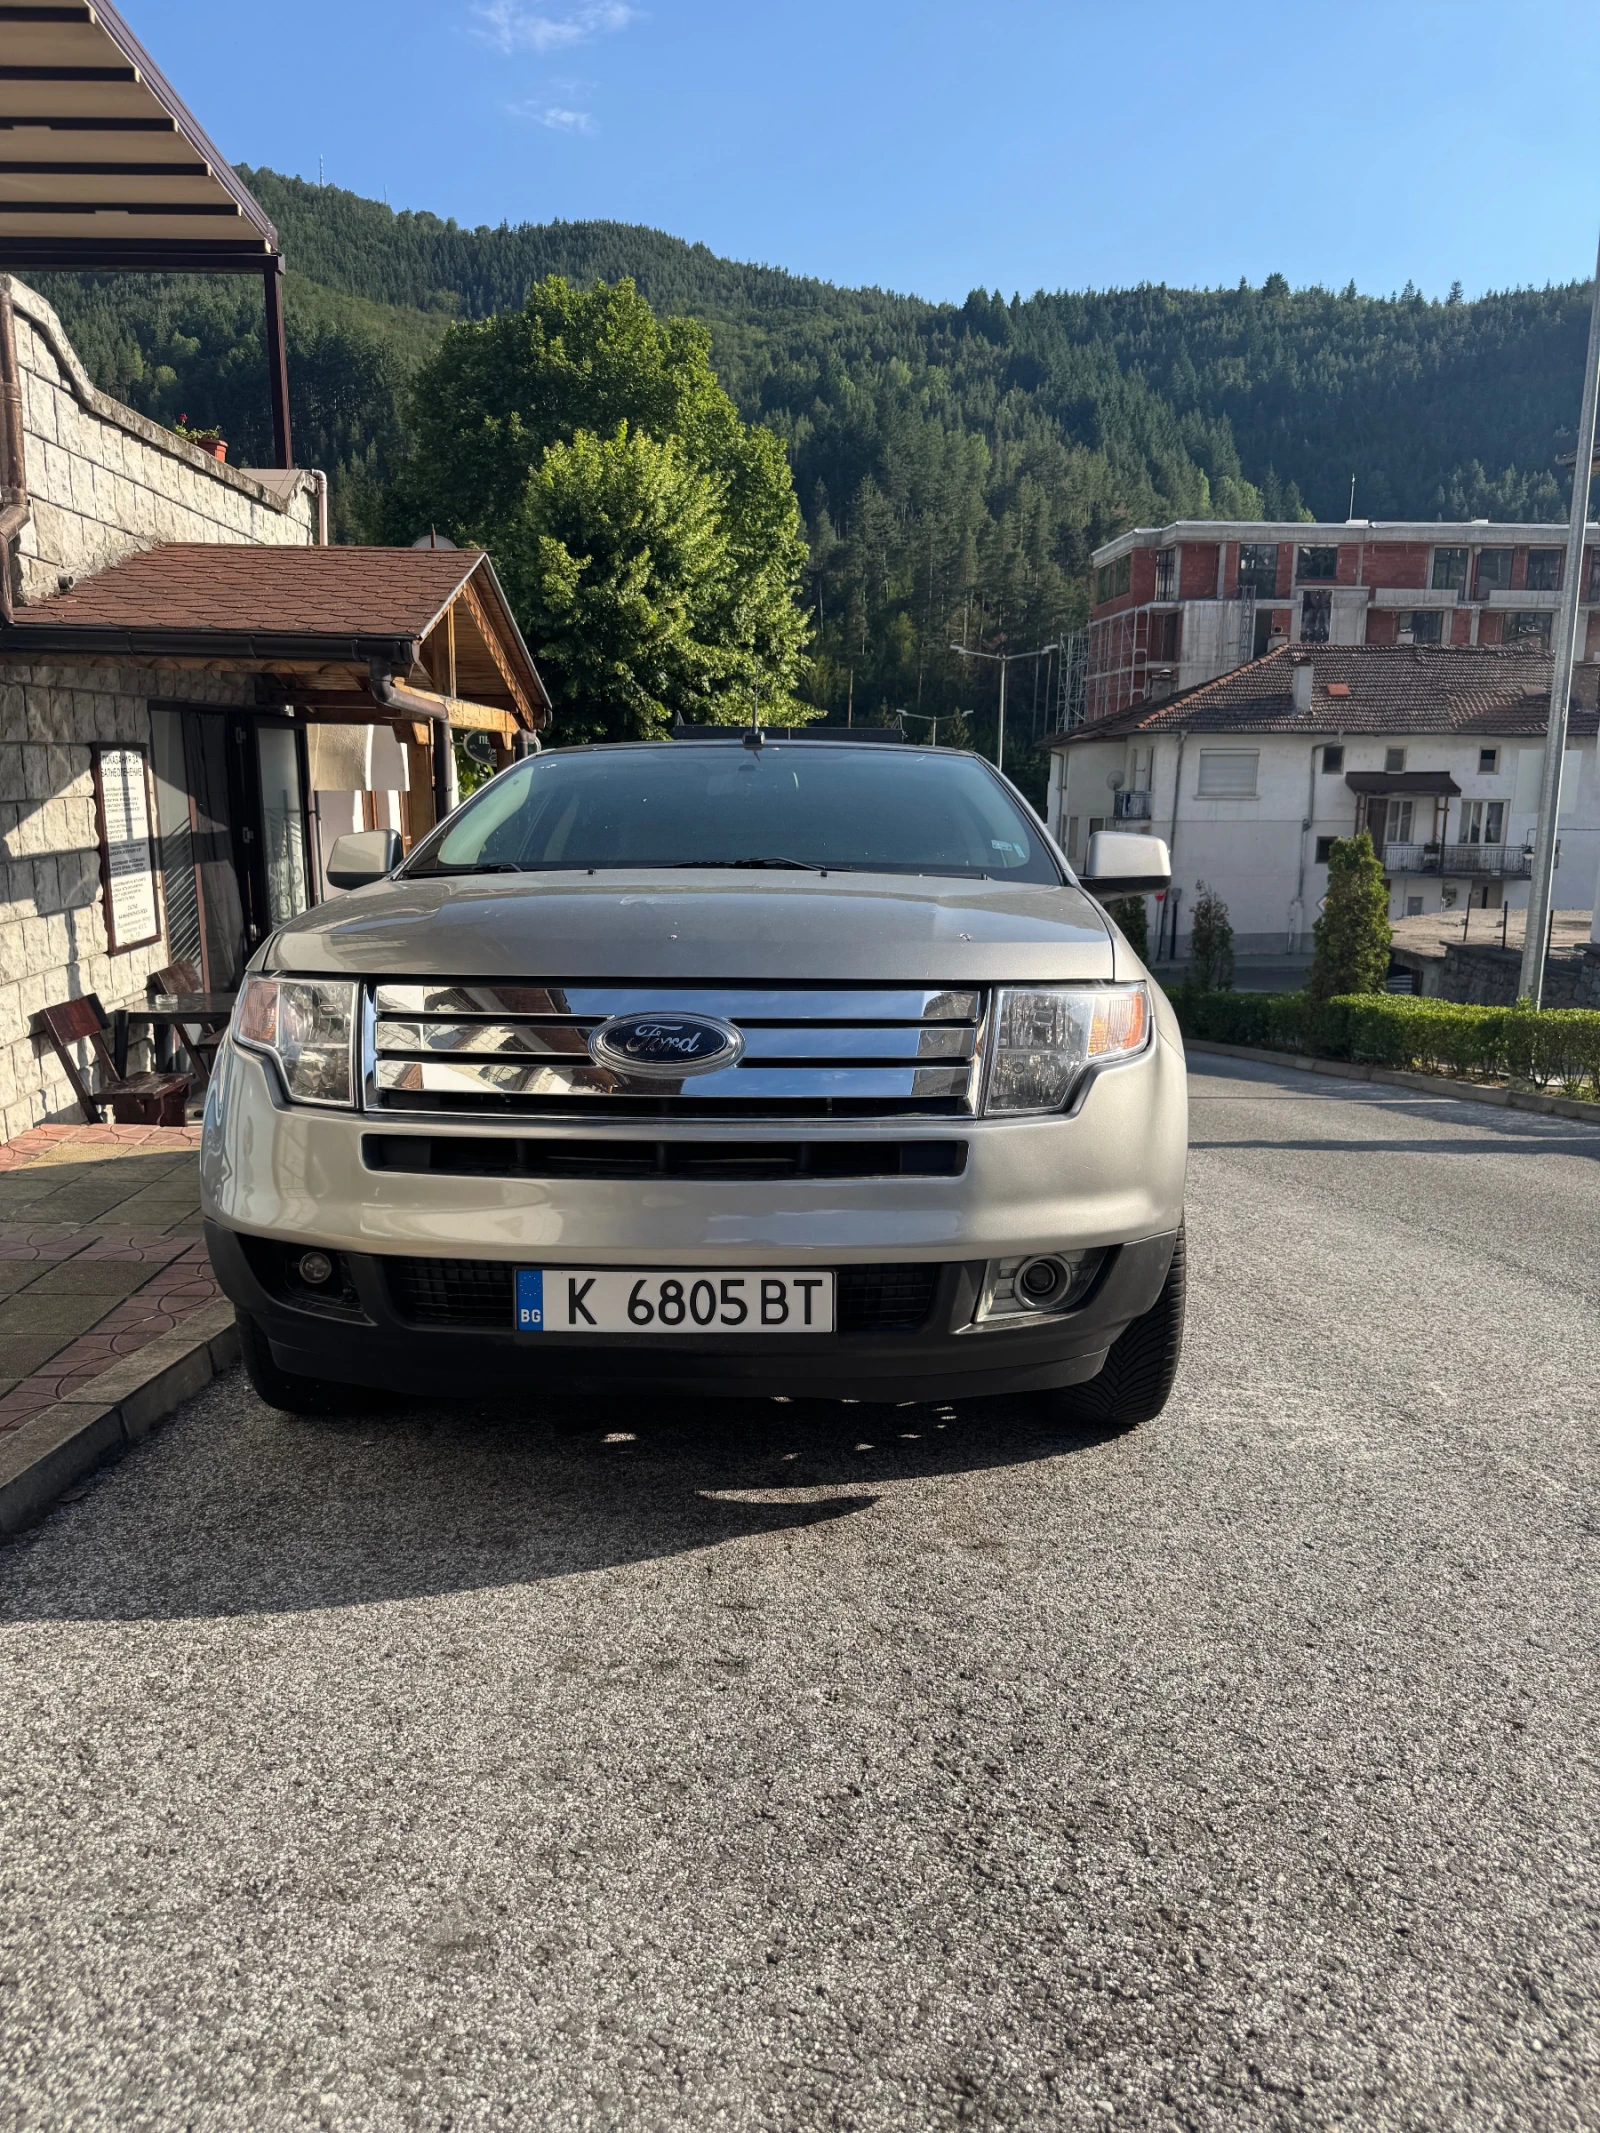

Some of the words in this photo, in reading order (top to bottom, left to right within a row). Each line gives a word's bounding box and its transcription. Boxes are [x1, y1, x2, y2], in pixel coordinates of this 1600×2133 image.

[626, 1024, 702, 1053] Ford
[520, 1309, 541, 1323] BG
[567, 1278, 598, 1325] K
[627, 1279, 748, 1326] 6805
